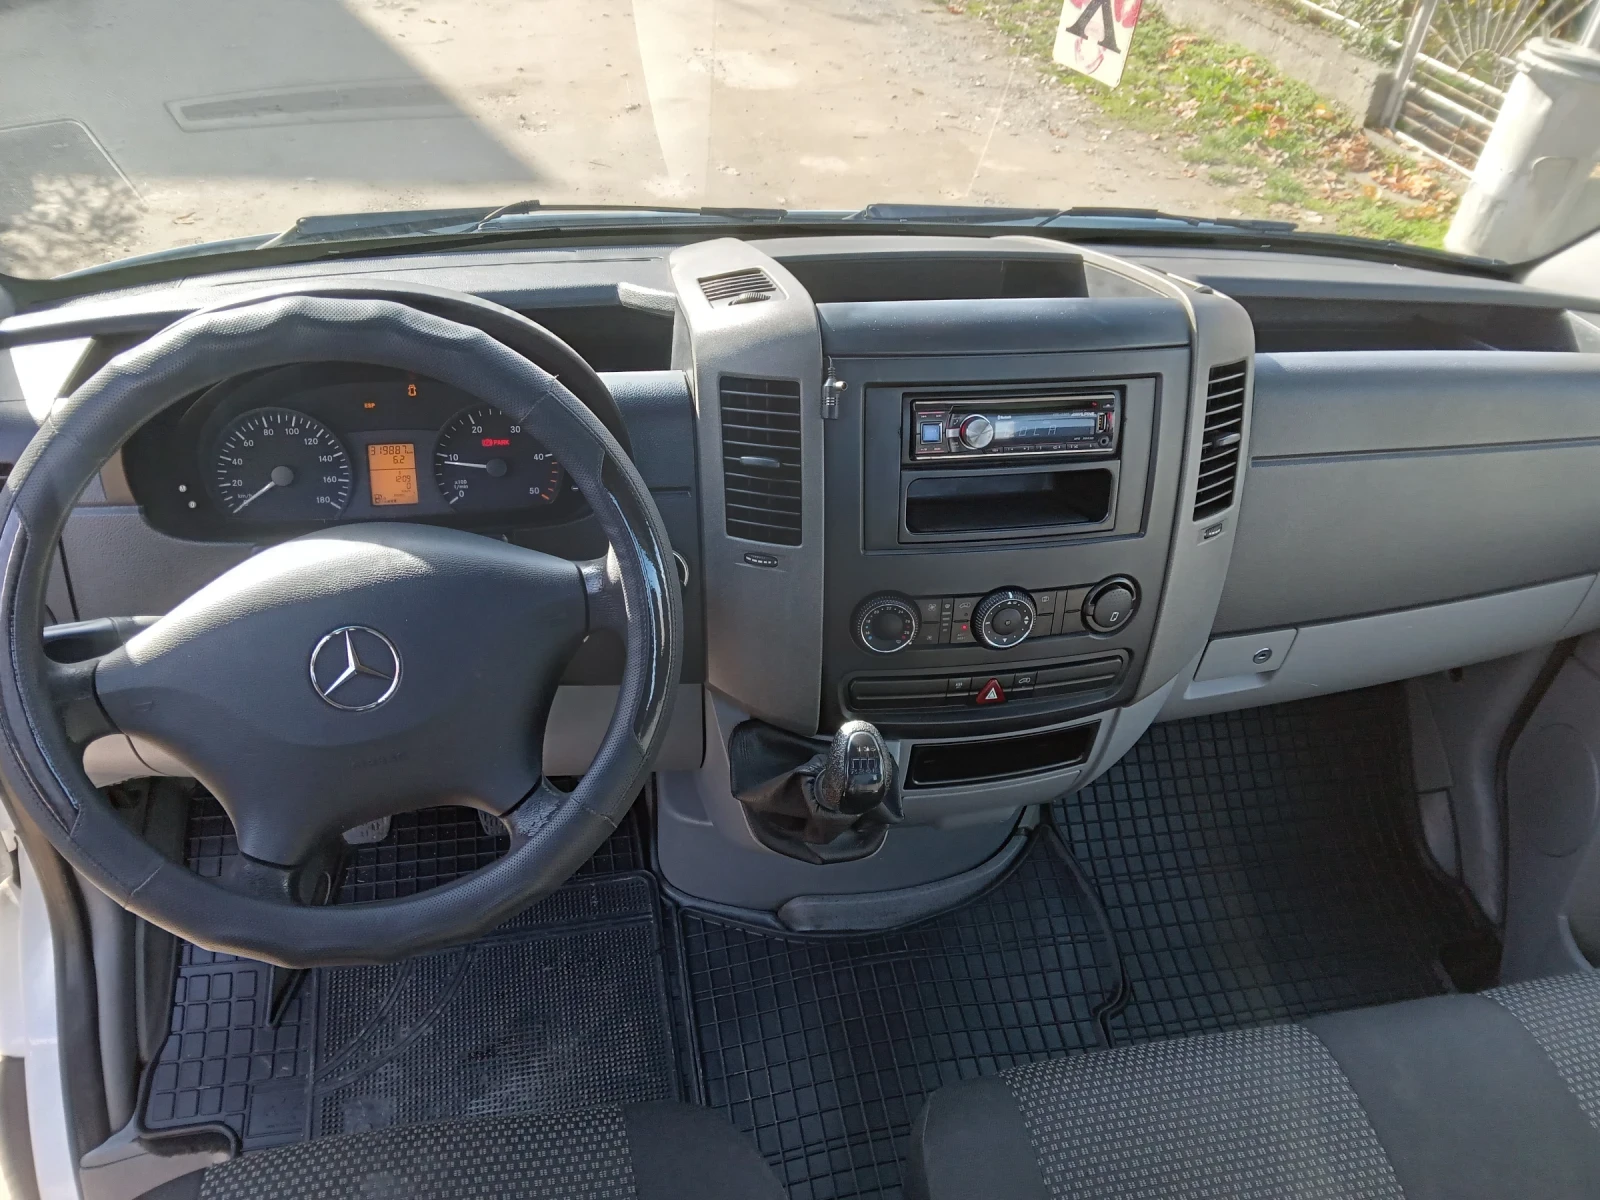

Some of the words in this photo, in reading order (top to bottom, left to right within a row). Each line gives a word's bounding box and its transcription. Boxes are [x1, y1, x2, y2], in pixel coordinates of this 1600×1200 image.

[263, 428, 274, 436] 80
[471, 426, 483, 434] 20
[243, 439, 254, 447] 60
[370, 445, 407, 456] 319887
[318, 455, 333, 463] 140
[448, 453, 459, 461] 10
[533, 453, 544, 461] 40
[458, 489, 465, 498] 0
[529, 487, 540, 495] 50
[316, 496, 331, 504] 180
